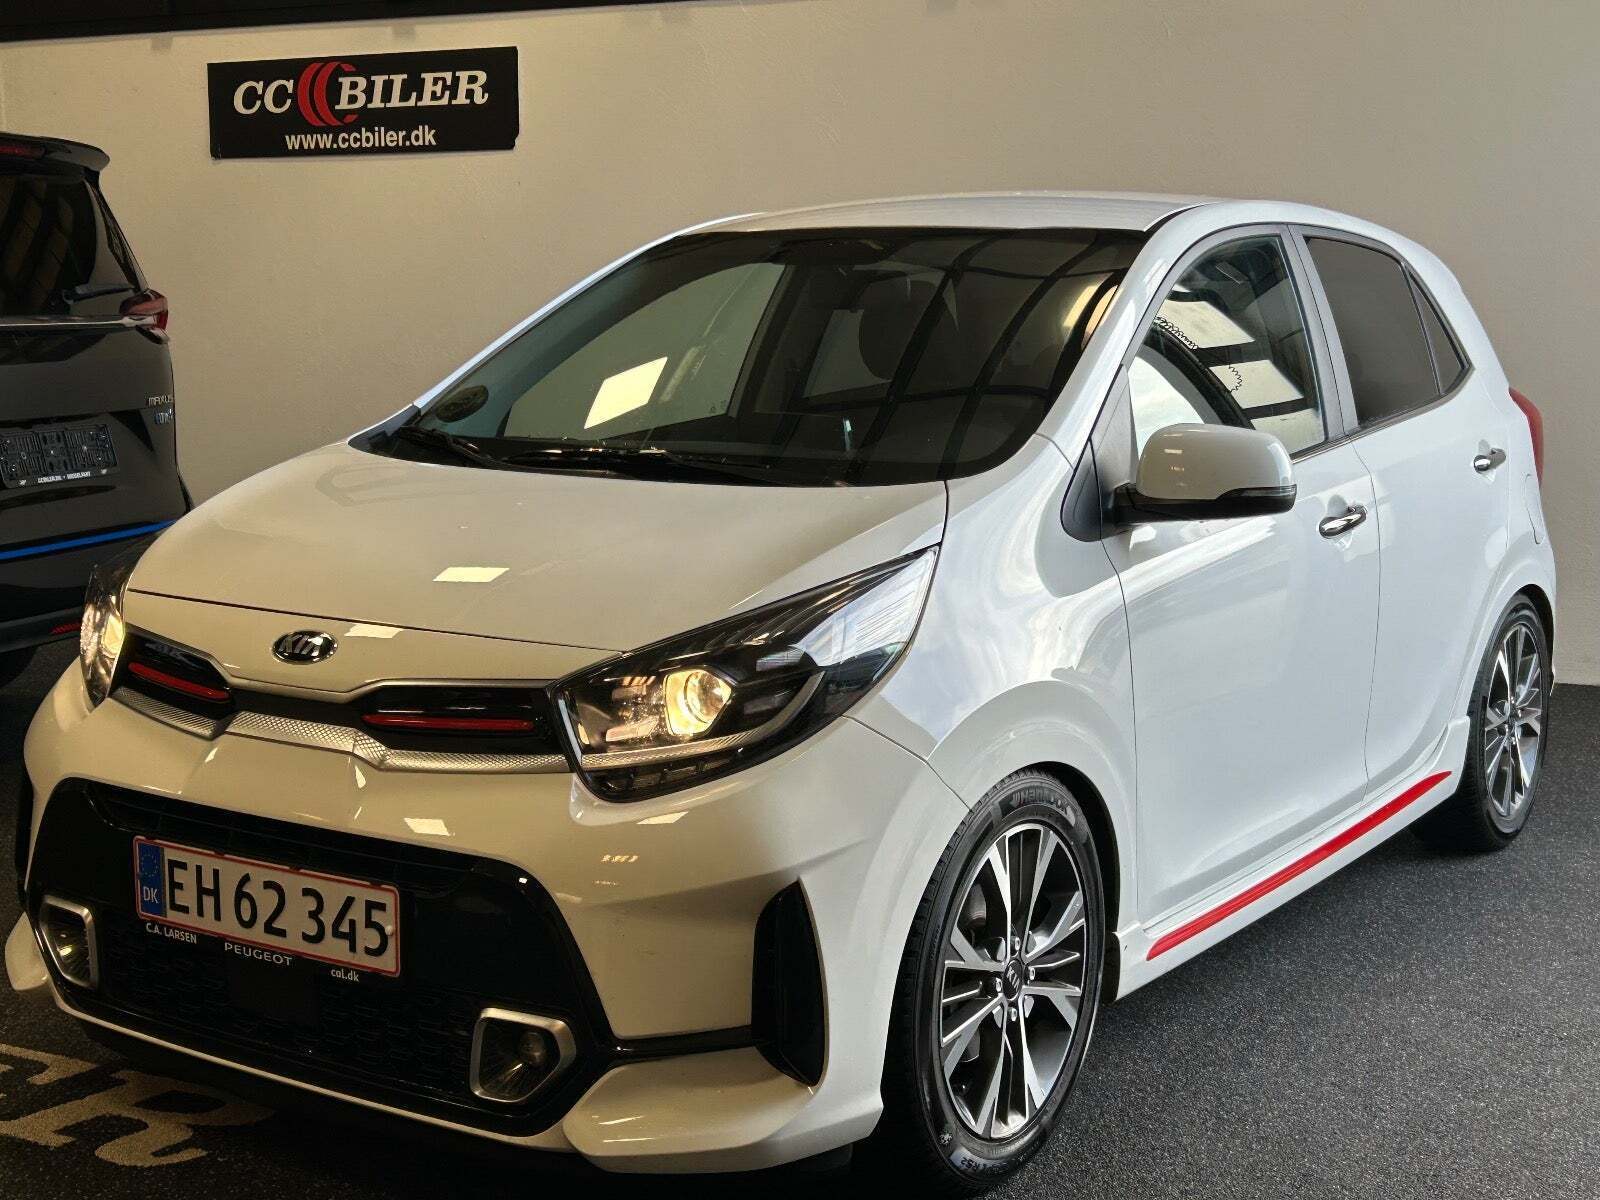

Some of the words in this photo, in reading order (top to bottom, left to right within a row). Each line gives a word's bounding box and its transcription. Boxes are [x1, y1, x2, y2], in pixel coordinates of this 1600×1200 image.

[233, 78, 294, 115] CC
[334, 70, 489, 110] BILER
[285, 125, 437, 150] www.ccbiler.dk
[143, 886, 159, 904] DK
[167, 859, 222, 921] EH
[234, 873, 287, 938] 62
[302, 887, 389, 957] 345
[145, 922, 163, 936] C.A.
[164, 926, 197, 944] LARSEN
[224, 942, 292, 967] PEUGEOT
